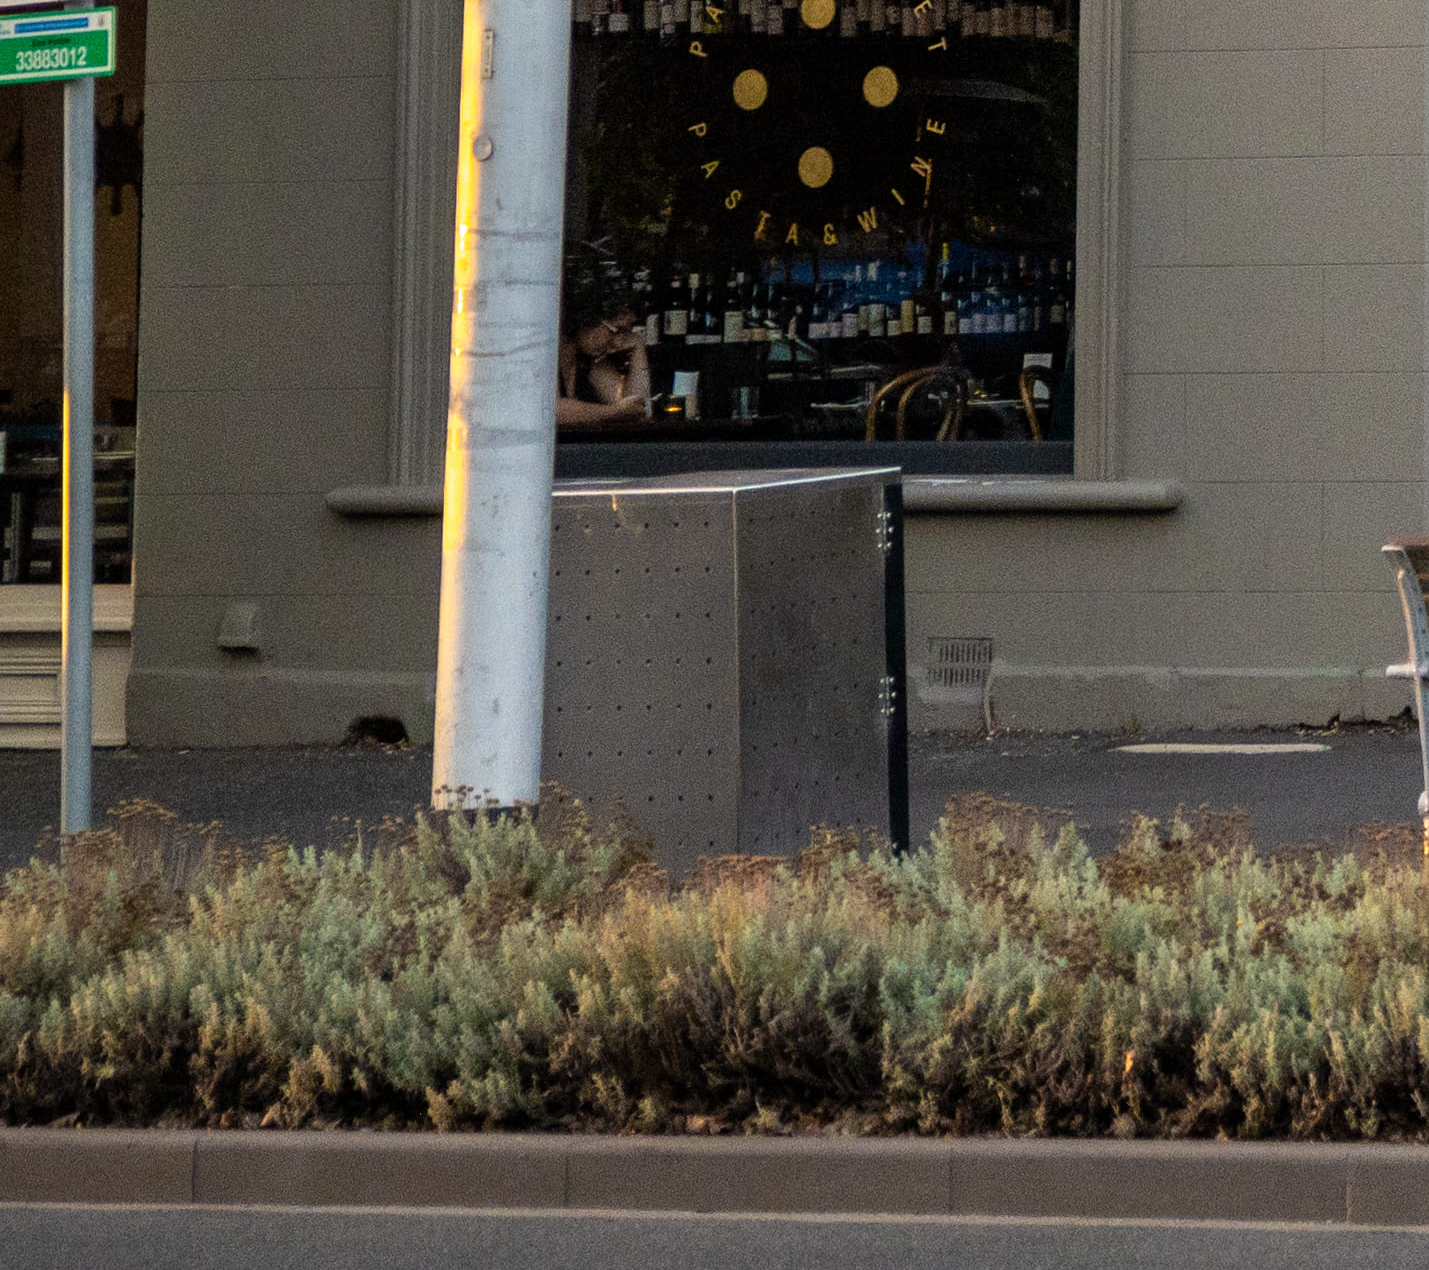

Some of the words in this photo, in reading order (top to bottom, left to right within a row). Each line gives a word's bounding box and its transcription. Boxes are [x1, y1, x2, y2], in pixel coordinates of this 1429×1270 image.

[15, 46, 88, 72] 33883012
[688, 121, 800, 247] PASTA
[822, 222, 840, 247] &
[857, 116, 948, 234] WINE
